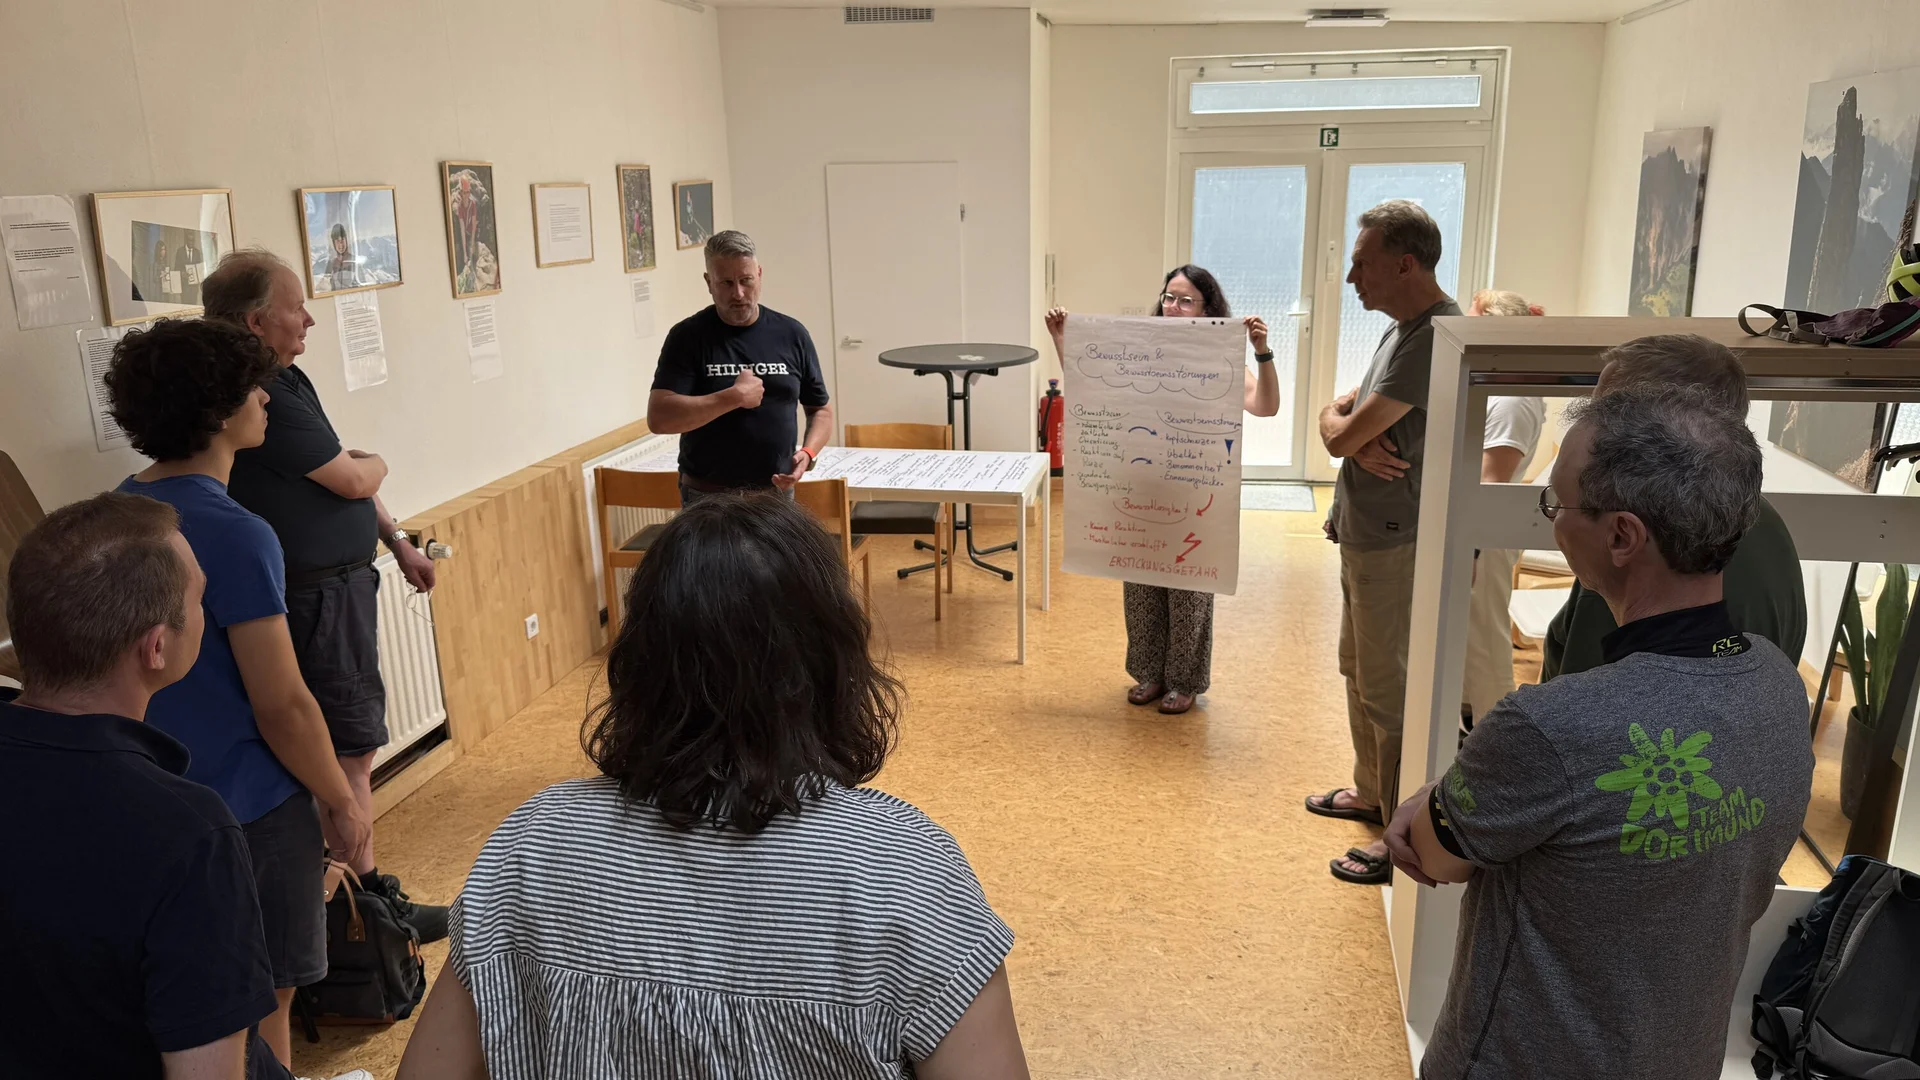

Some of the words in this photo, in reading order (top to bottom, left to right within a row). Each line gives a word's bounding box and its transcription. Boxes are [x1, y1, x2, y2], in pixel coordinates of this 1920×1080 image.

[1085, 343, 1150, 362] Bewusstsein
[1155, 348, 1165, 361] &
[1108, 555, 1218, 580] ERSTICKUNGSGEFAHR
[1712, 635, 1740, 653] RC
[1713, 645, 1743, 658] TEAM
[1692, 786, 1746, 828] TEAM
